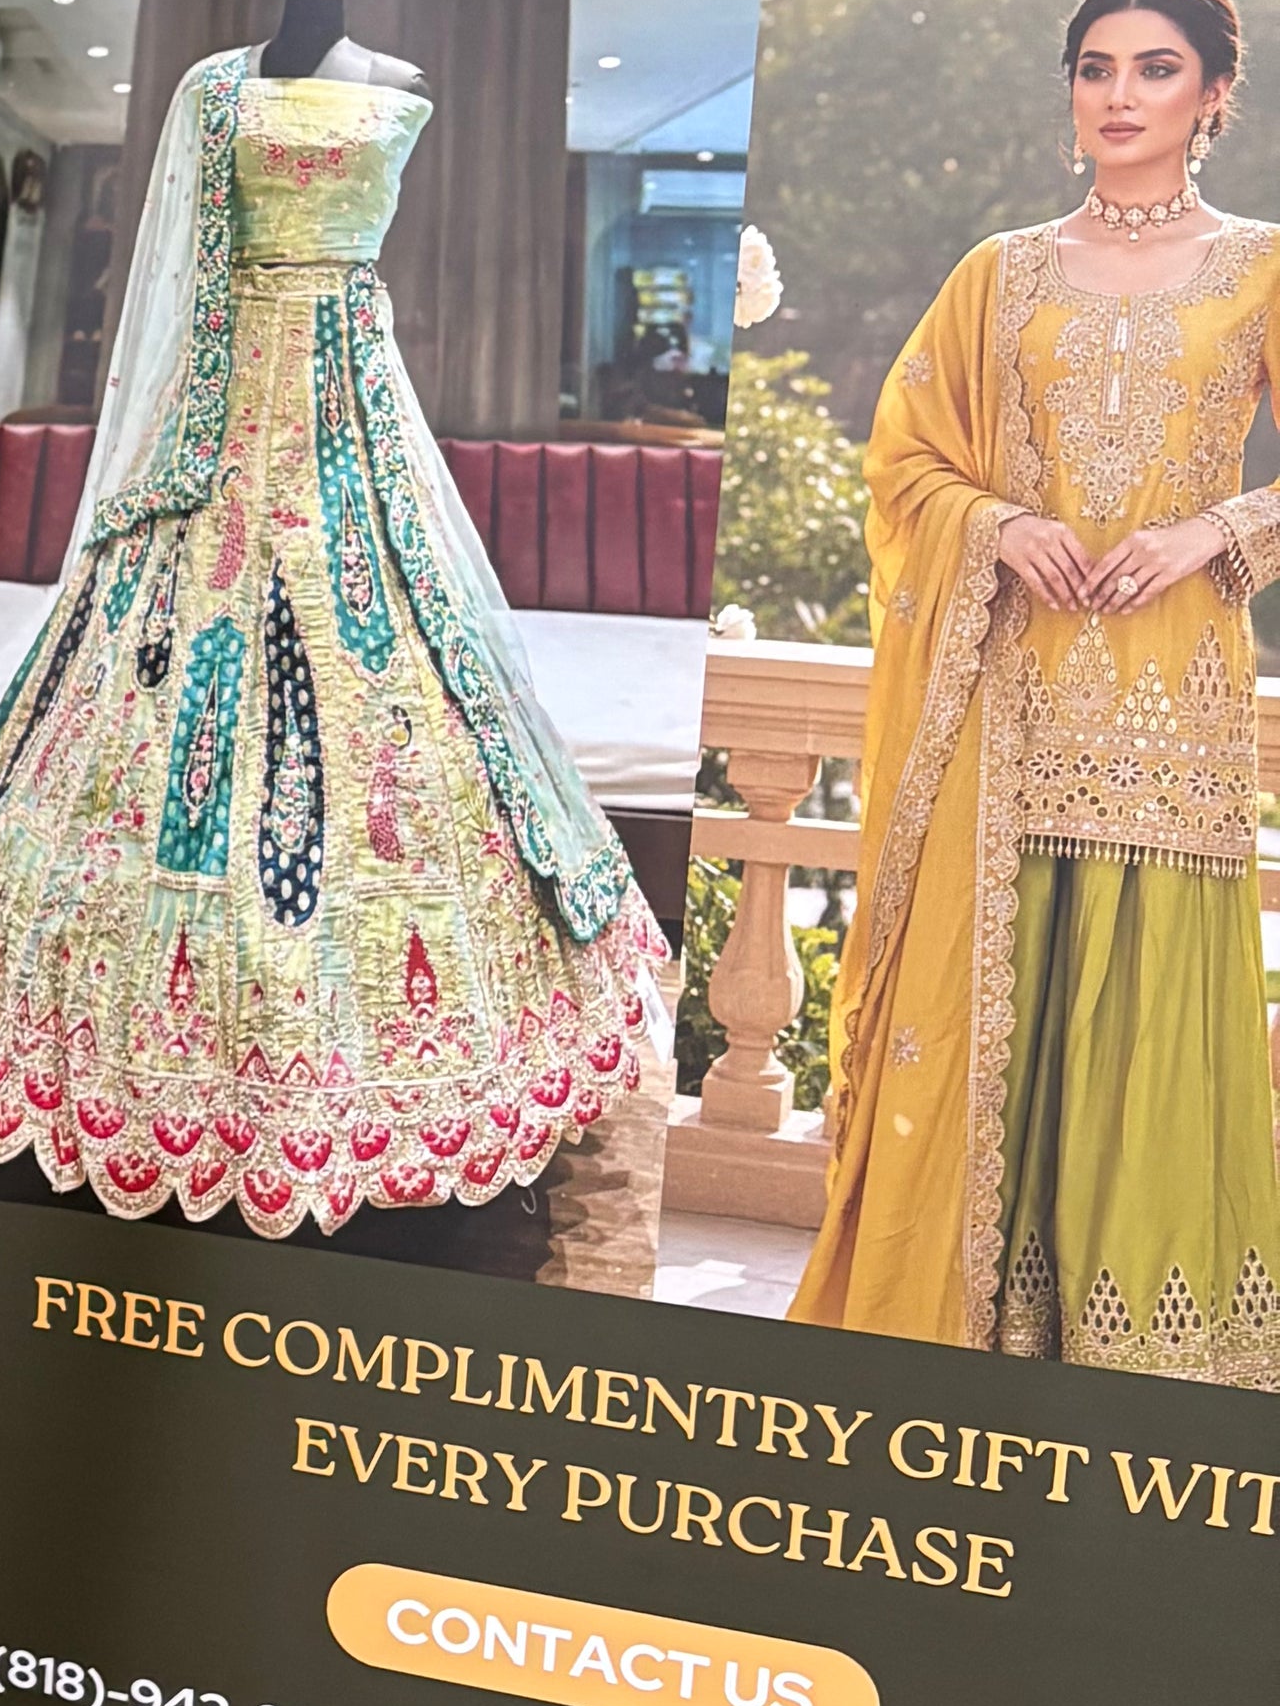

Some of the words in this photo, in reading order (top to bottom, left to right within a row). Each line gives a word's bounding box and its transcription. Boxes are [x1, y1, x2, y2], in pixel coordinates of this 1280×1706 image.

[33, 1277, 205, 1357] FREE
[224, 1313, 872, 1465] COMPLIMENTRY
[889, 1420, 1089, 1502] GIFT
[1109, 1451, 1280, 1535] WIT
[292, 1418, 547, 1511] EVERY
[561, 1465, 1014, 1597] PURCHASE
[385, 1597, 712, 1701] CONTACT
